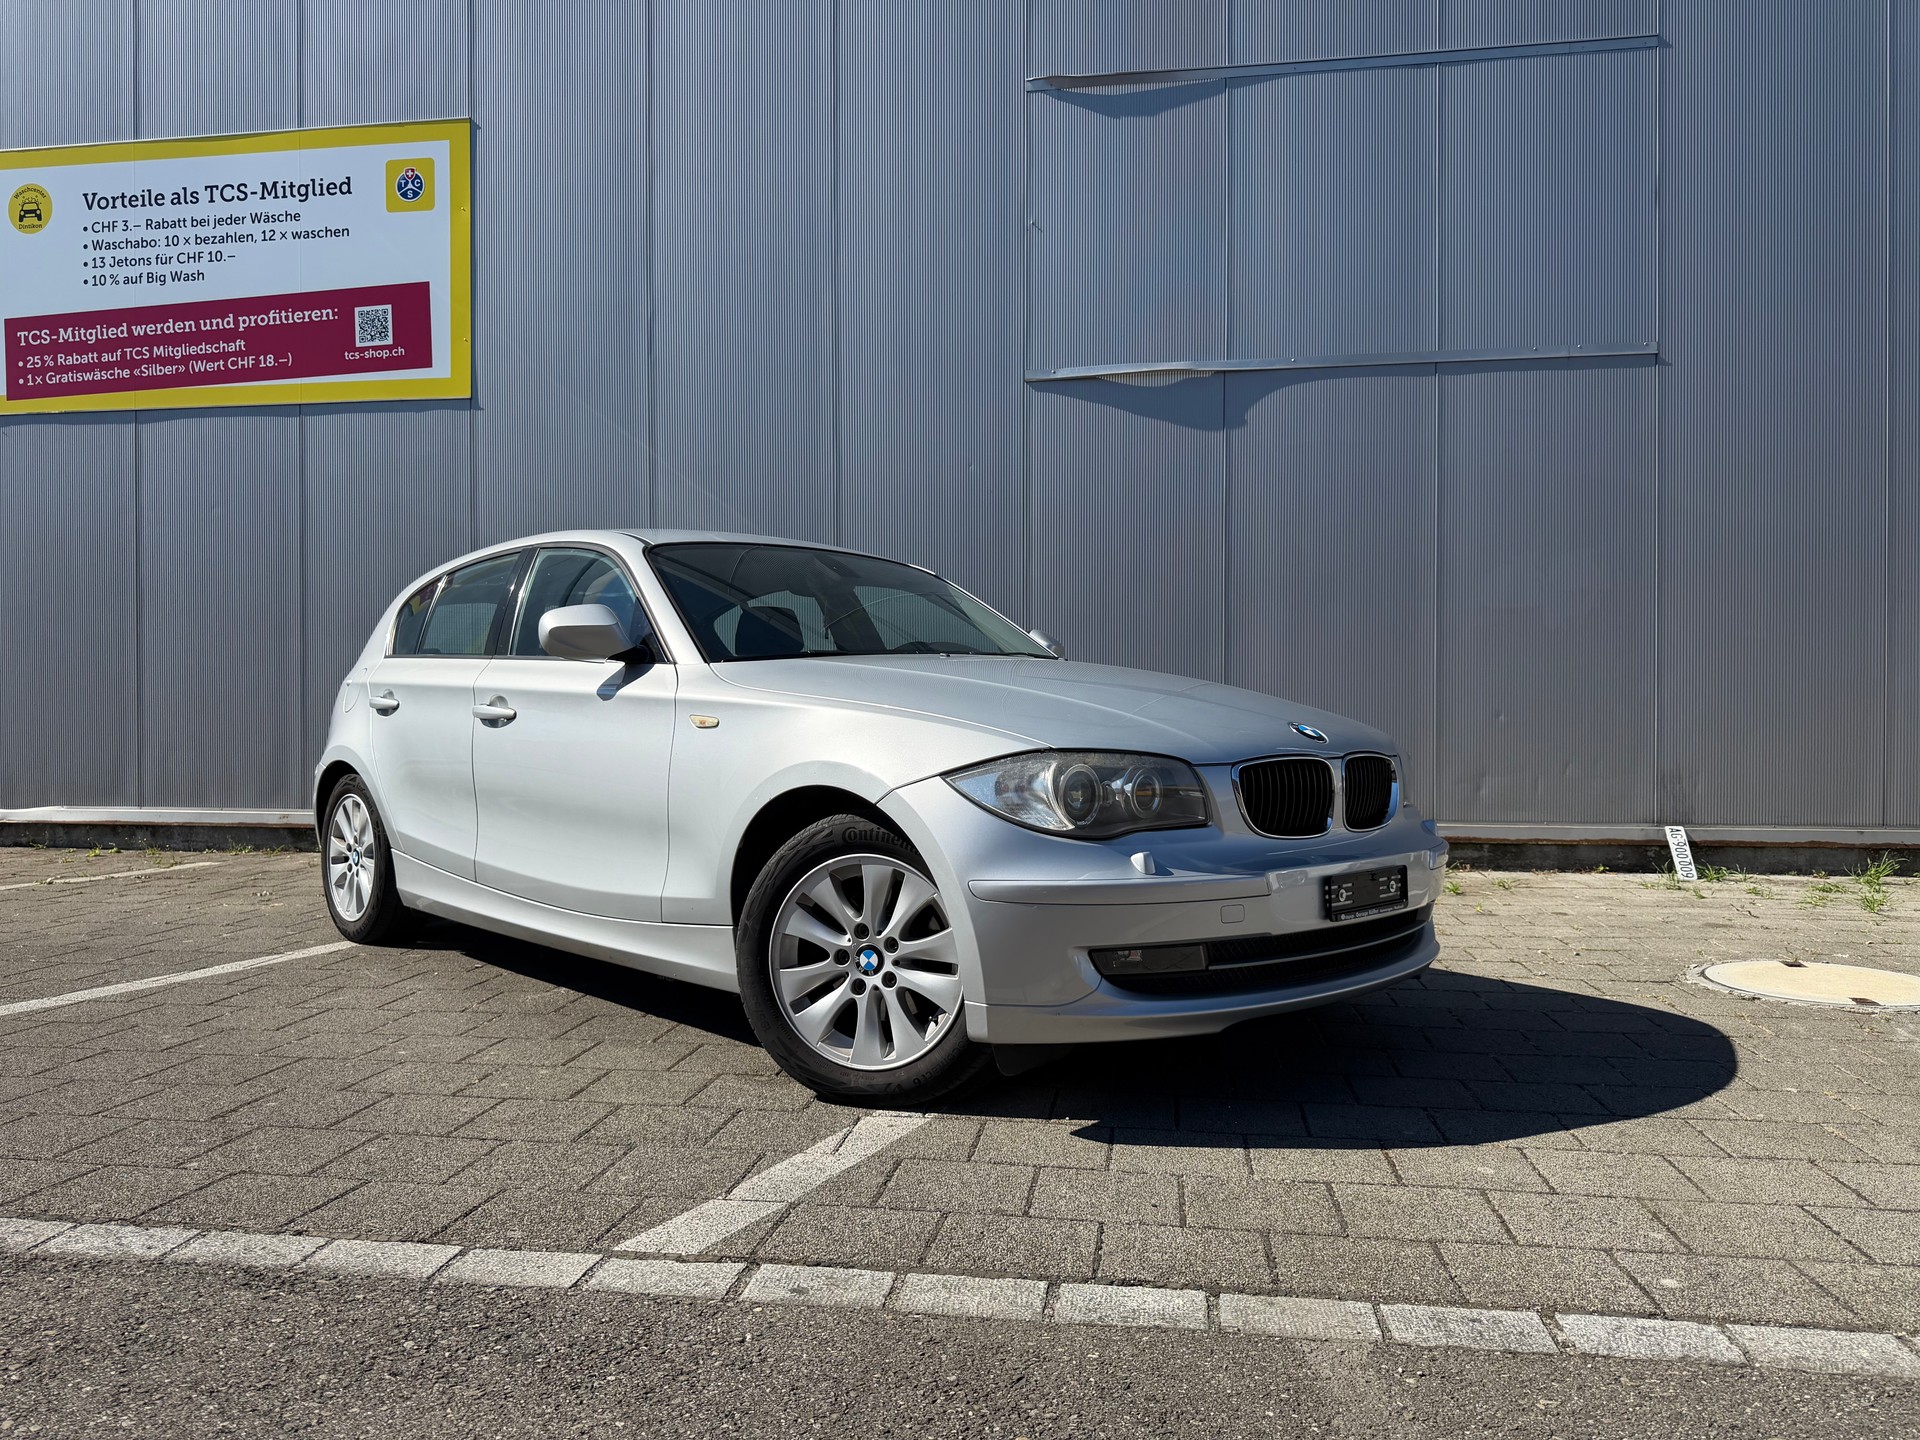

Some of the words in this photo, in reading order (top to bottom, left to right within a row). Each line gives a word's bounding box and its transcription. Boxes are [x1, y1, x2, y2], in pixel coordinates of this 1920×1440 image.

[13, 186, 47, 200] Waschcenter
[82, 189, 165, 210] Vorteile
[170, 187, 199, 206] als
[204, 176, 352, 203] TCS-Mitglied
[91, 220, 118, 233] CHF
[146, 217, 187, 230] Rabatt
[191, 215, 210, 228] bei
[212, 214, 247, 230] jeder
[250, 210, 301, 224] Wäsche
[91, 237, 160, 251] Waschabo:
[195, 231, 257, 245] bezahlen,
[261, 229, 276, 242] 12
[291, 226, 349, 240] waschen
[92, 257, 106, 269] 13
[109, 256, 152, 268] Jetons
[155, 253, 174, 265] für
[177, 251, 204, 264] CHF
[123, 272, 143, 285] auf
[147, 271, 166, 286] Big
[170, 269, 204, 282] Wash
[17, 323, 128, 346] TCS-Mitglied
[131, 319, 196, 336] werden
[199, 314, 235, 331] und
[238, 308, 338, 331] profitieren:
[57, 352, 98, 366] Rabatt
[101, 349, 122, 362] auf
[124, 346, 150, 360] TCS
[153, 339, 246, 359] Mitgliedschaft
[344, 346, 405, 360] tcs-shop.ch
[46, 367, 130, 384] Gratiswäsche
[133, 363, 185, 376] «Silber»
[189, 359, 225, 374] (Wert
[228, 356, 256, 370] CHF
